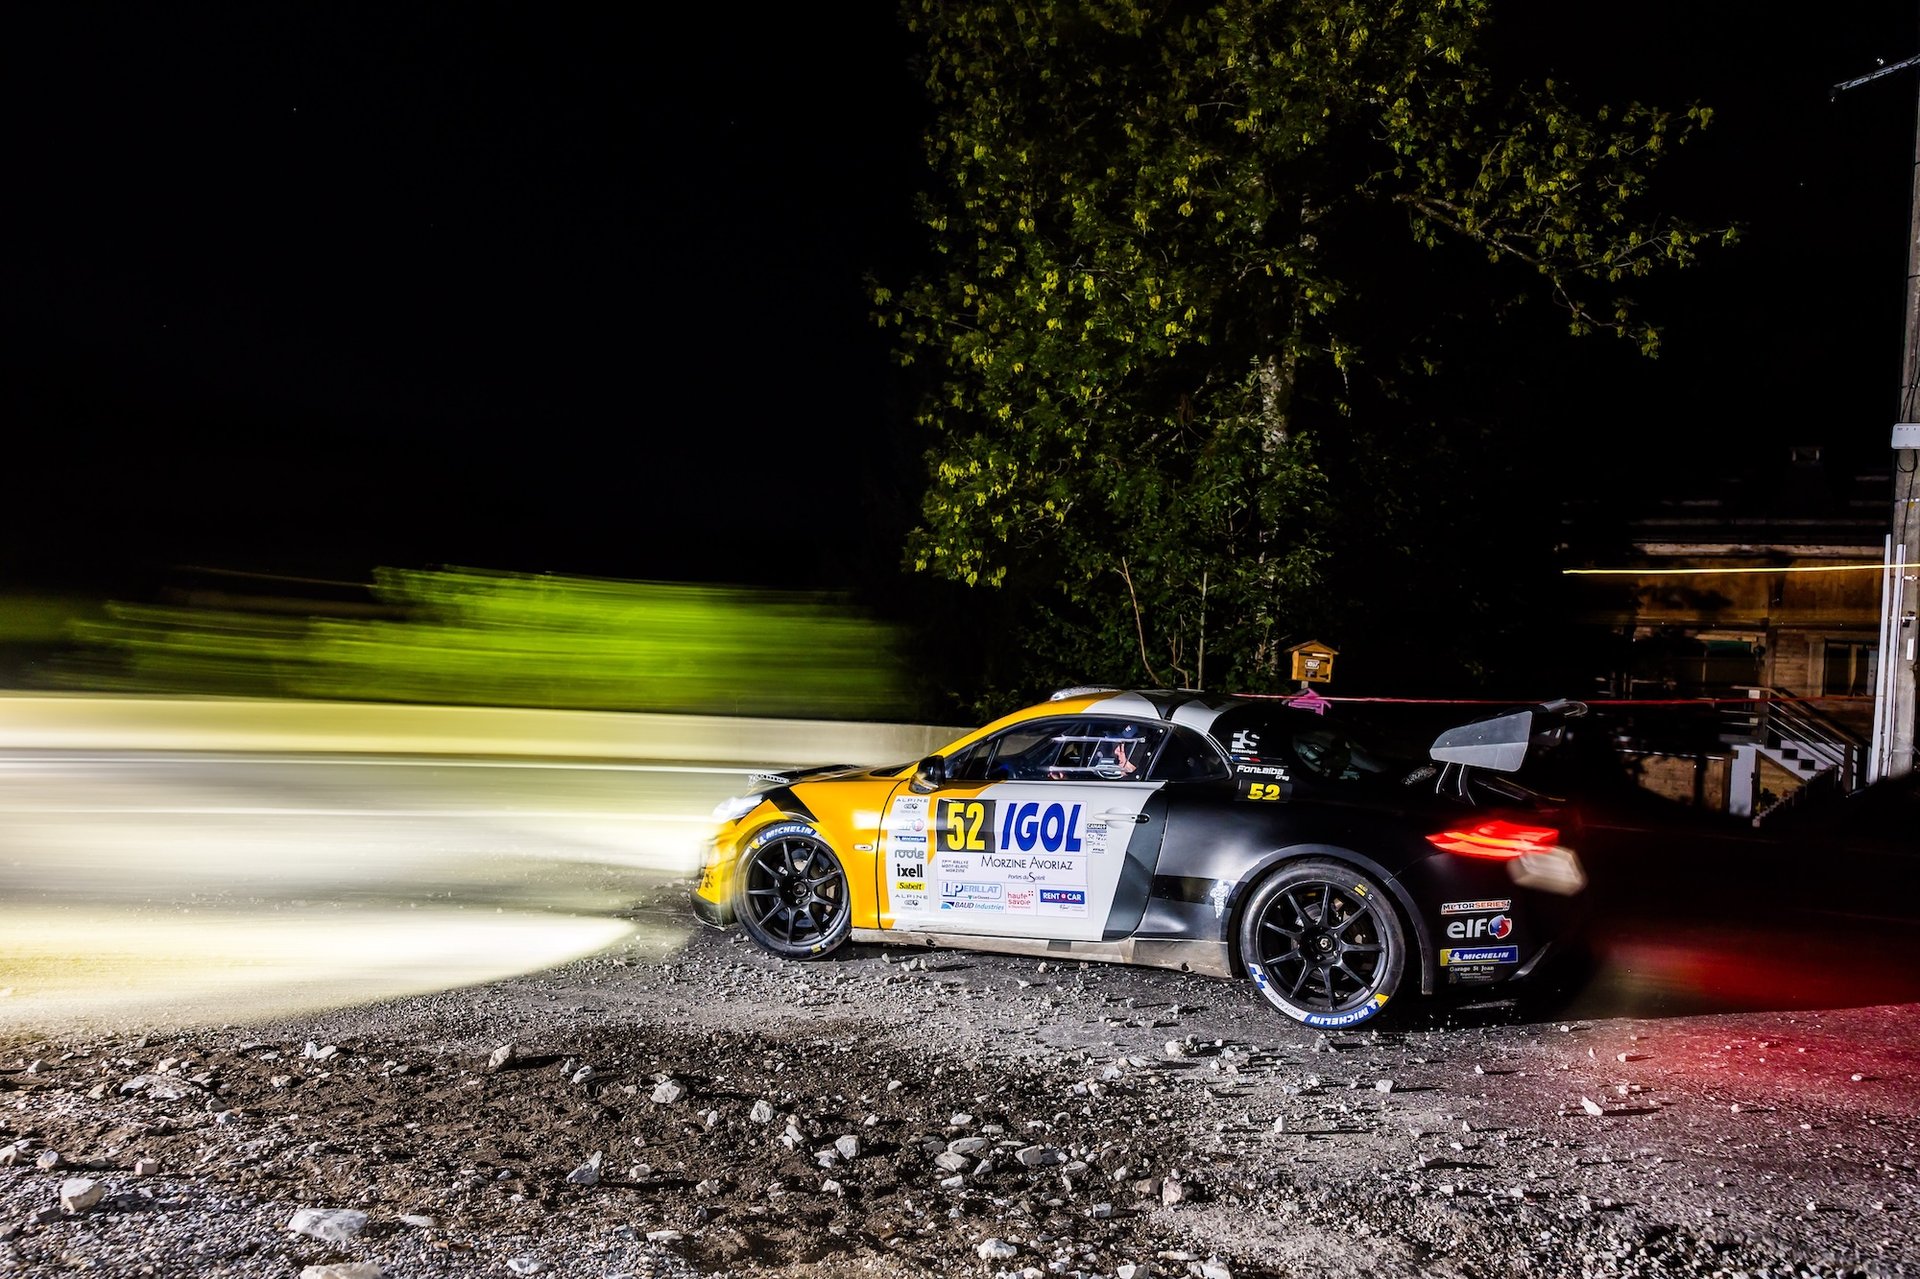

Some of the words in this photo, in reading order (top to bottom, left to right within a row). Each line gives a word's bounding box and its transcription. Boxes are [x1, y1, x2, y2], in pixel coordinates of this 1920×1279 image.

[1247, 783, 1280, 800] 52
[766, 826, 814, 838] MICHELIN
[946, 802, 985, 850] 52
[1000, 802, 1082, 852] IGOL
[897, 864, 923, 878] ixell
[899, 882, 922, 890] Sabelt
[1007, 891, 1028, 899] haute
[1043, 892, 1060, 900] RENT
[1067, 893, 1081, 901] CAR
[1446, 918, 1487, 938] elf
[1310, 1008, 1370, 1025] MICHELIN
